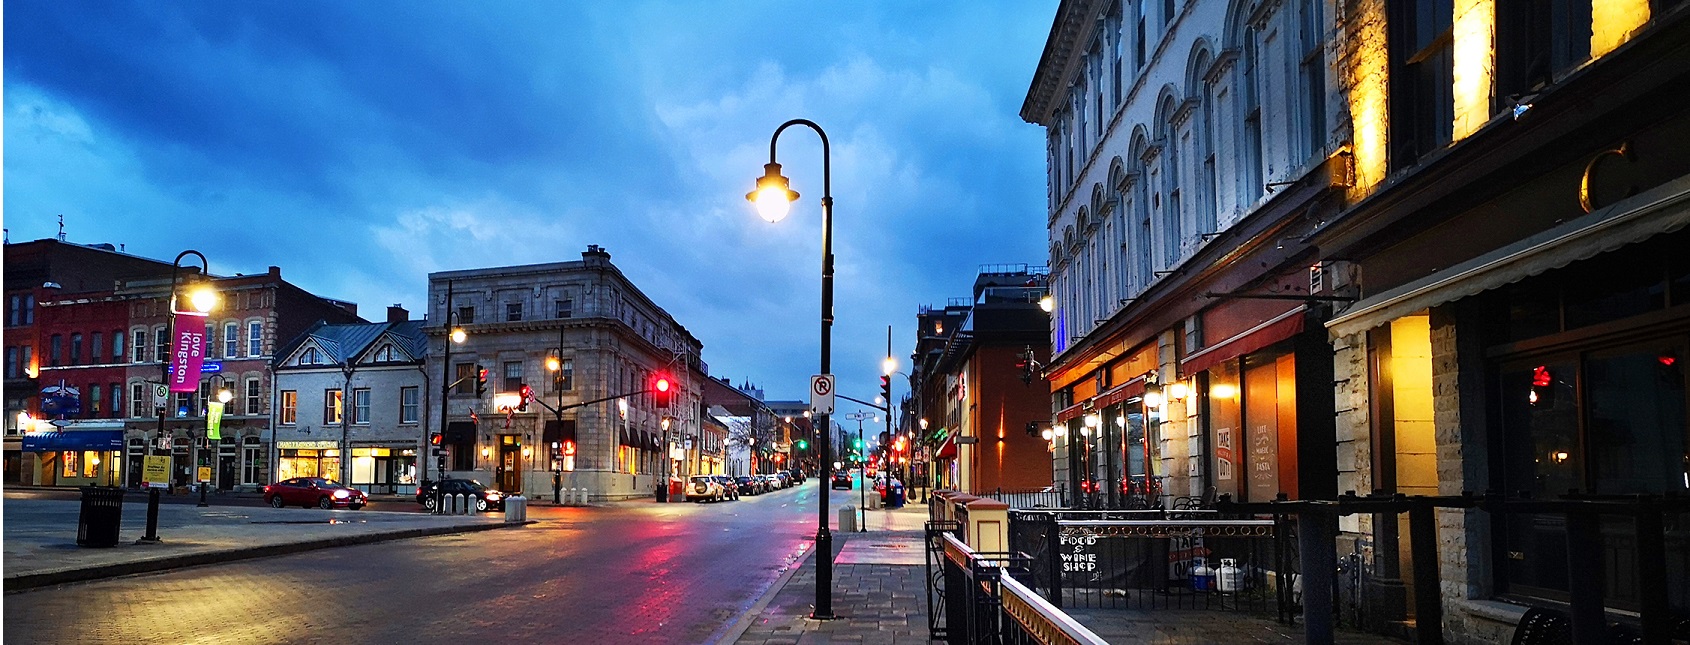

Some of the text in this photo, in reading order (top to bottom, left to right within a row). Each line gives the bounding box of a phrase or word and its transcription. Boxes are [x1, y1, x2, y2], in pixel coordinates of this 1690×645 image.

[191, 333, 203, 357] love
[176, 332, 192, 384] Kingston
[1060, 536, 1097, 545] FOOD
[1073, 545, 1085, 553] &
[1060, 553, 1097, 562] WINE
[1063, 562, 1096, 572] SHOP
